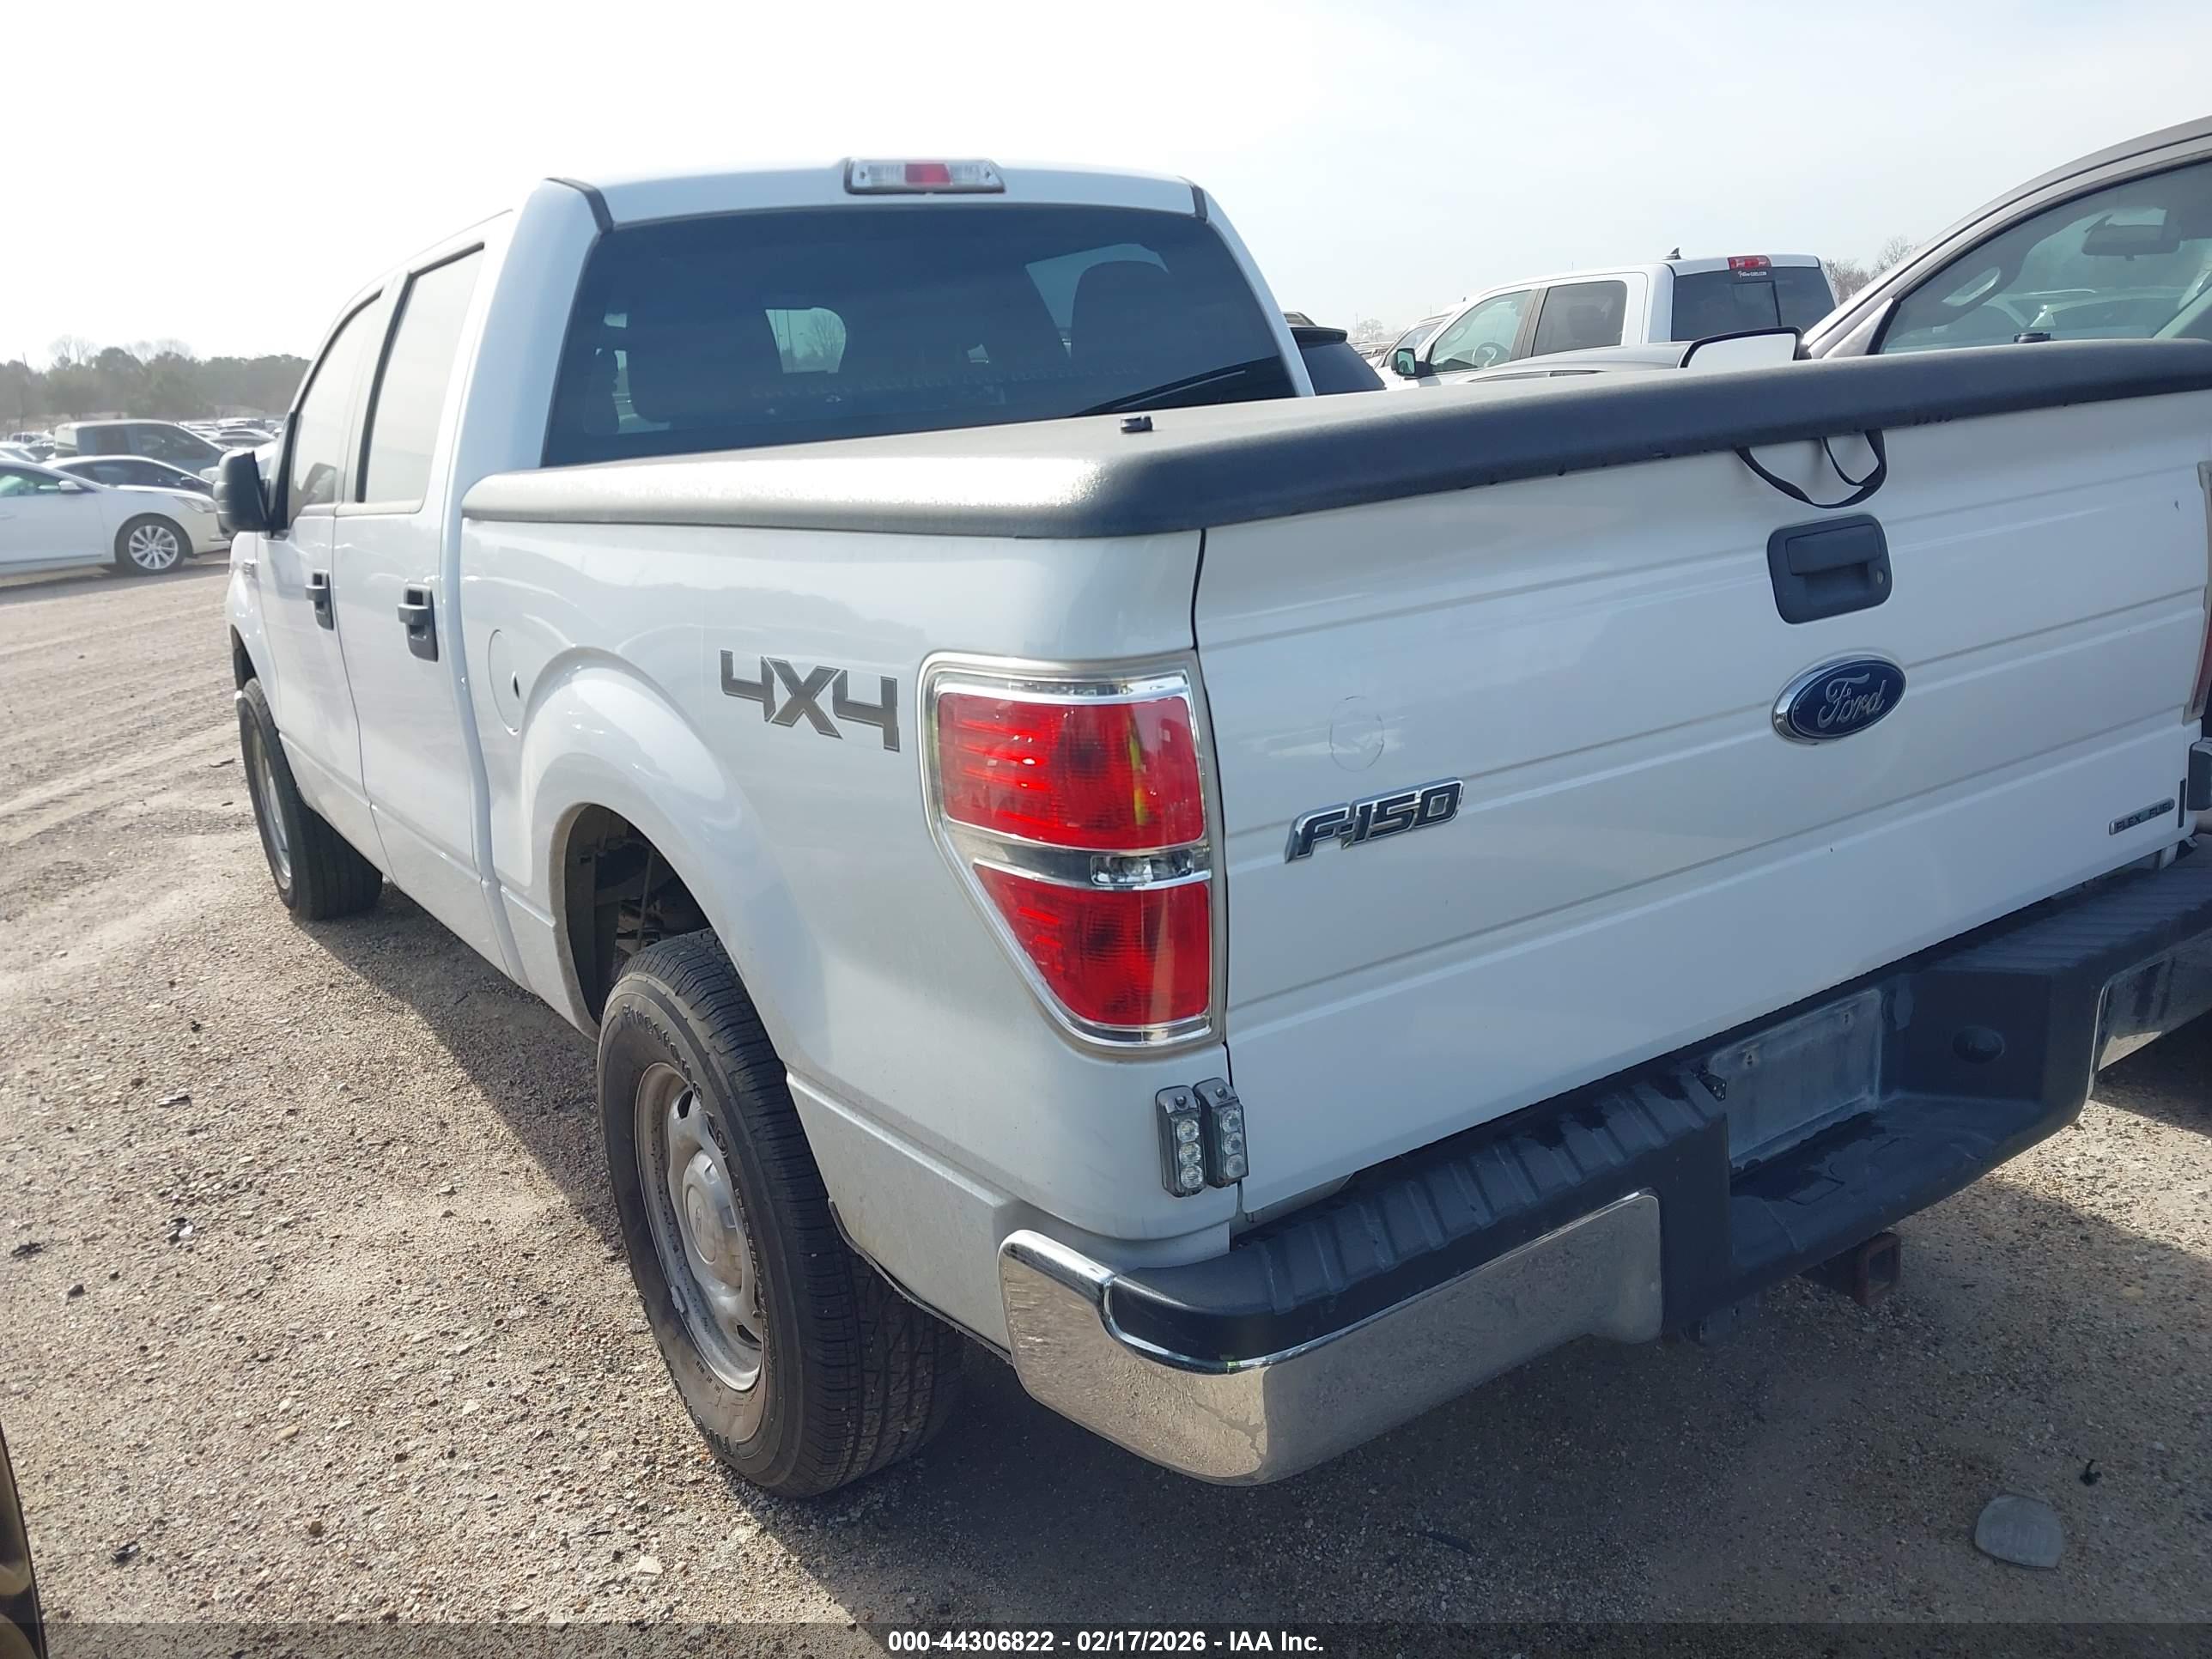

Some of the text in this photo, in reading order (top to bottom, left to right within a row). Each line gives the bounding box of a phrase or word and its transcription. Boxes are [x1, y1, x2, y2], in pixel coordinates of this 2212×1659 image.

[720, 649, 900, 752] 4X4
[1817, 672, 1887, 729] Ford
[1285, 776, 1464, 864] F-150
